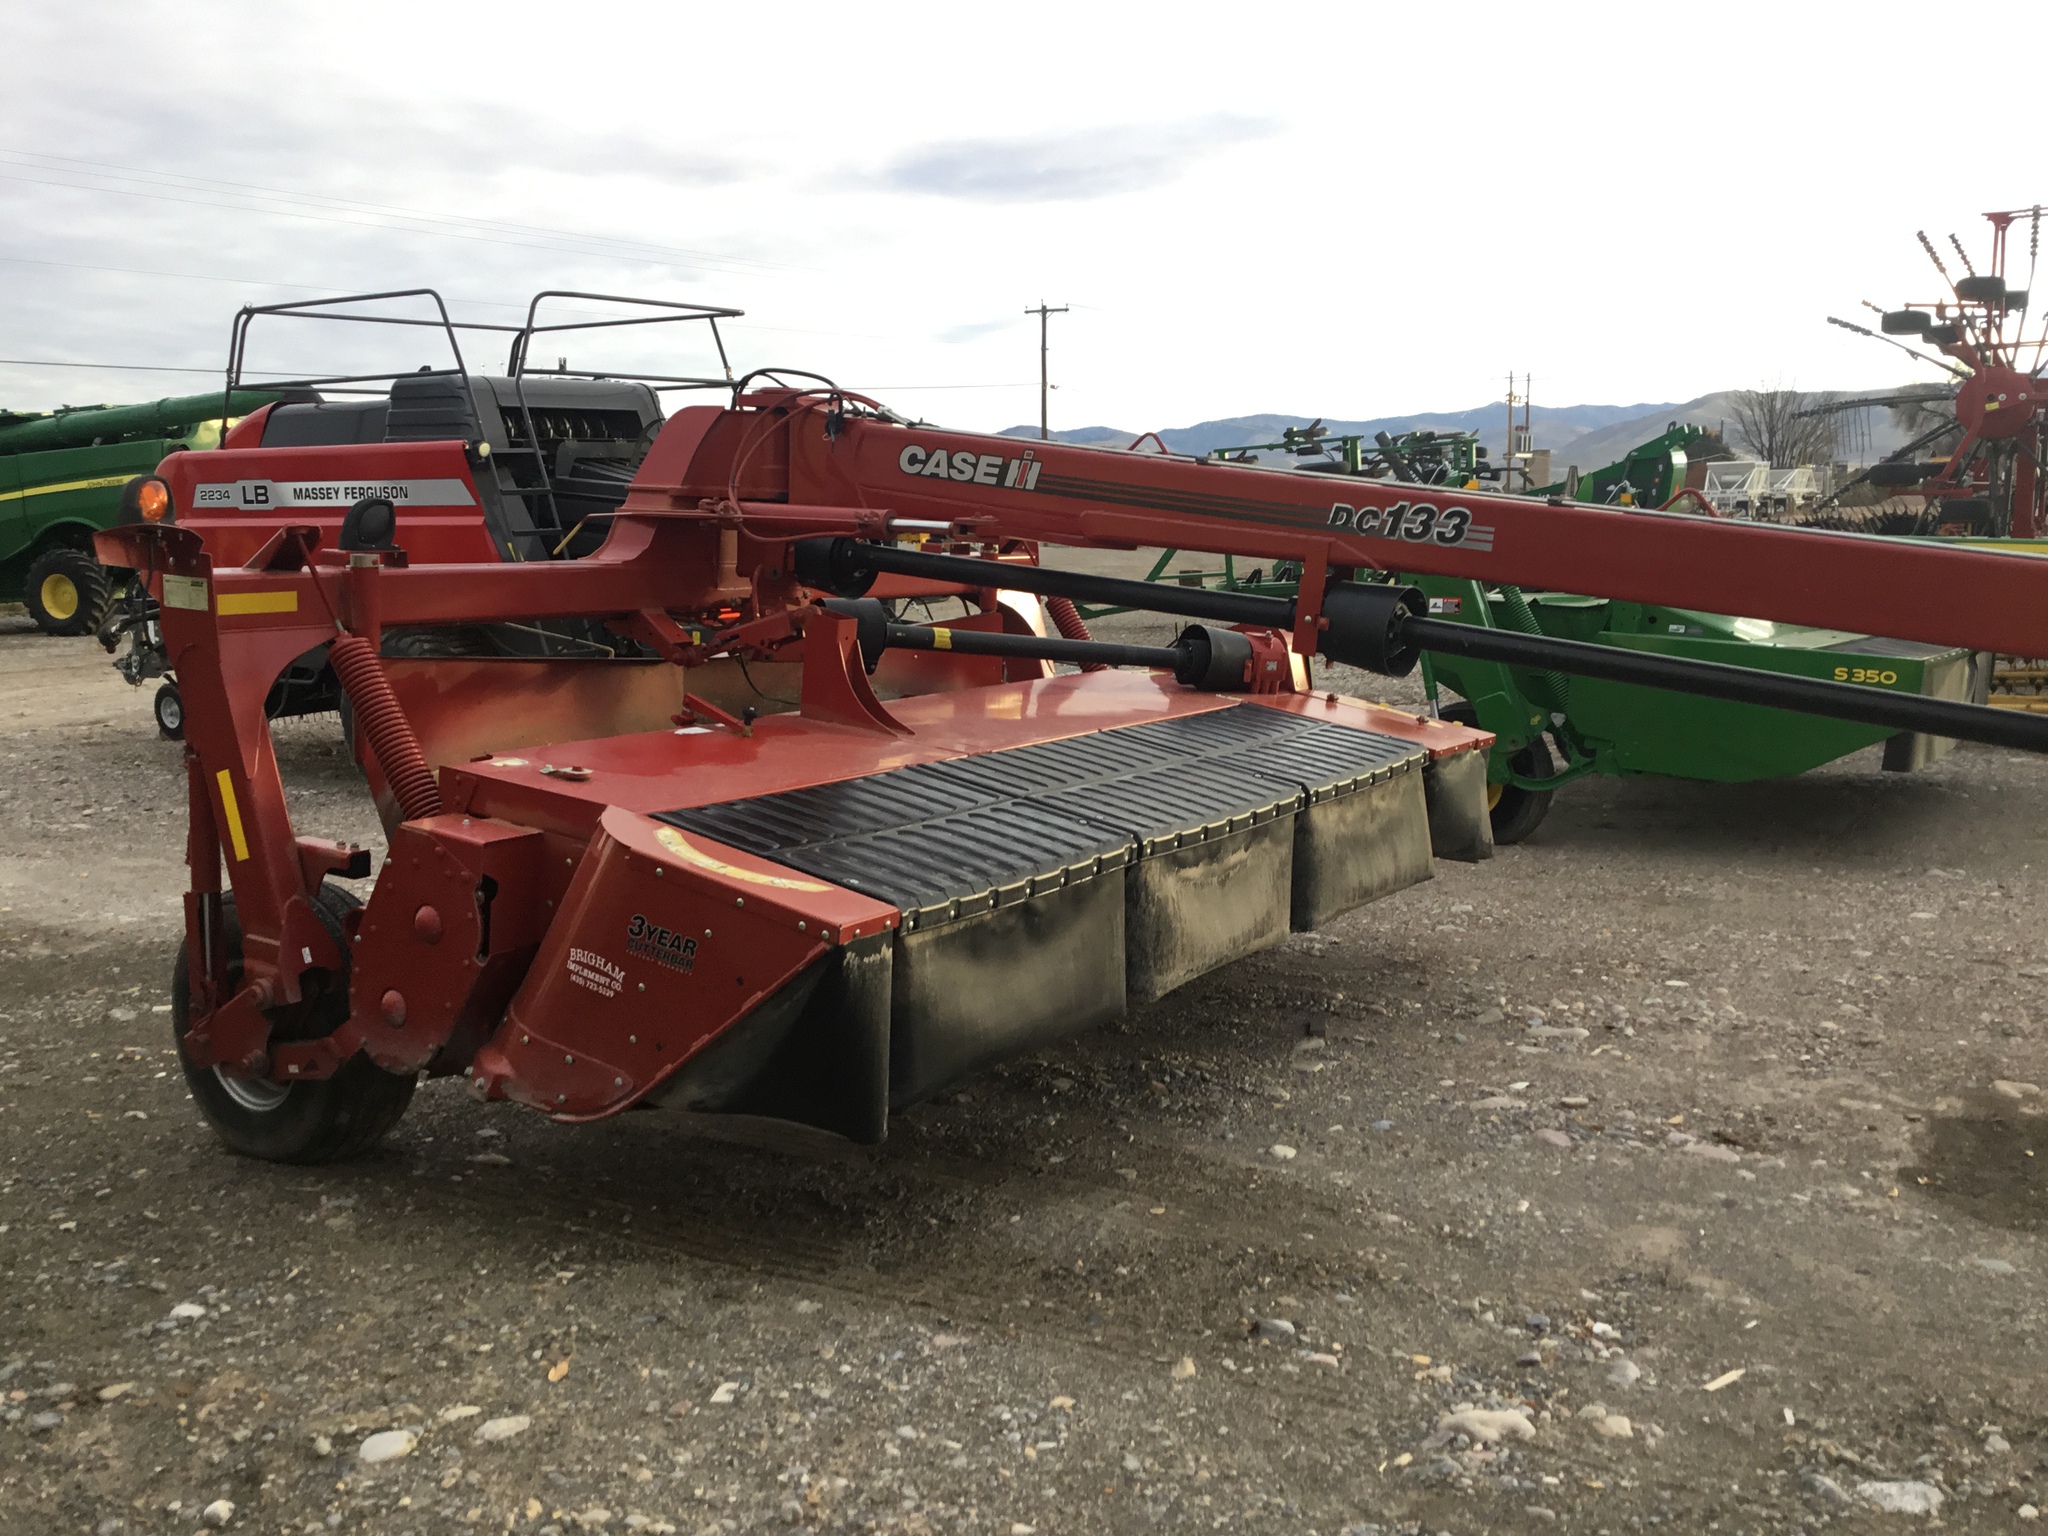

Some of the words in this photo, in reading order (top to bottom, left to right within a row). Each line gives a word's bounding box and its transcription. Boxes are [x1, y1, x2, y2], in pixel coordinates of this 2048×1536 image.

[899, 445, 1003, 485] CASE
[200, 490, 231, 500] 2234
[242, 485, 269, 504] LB
[293, 487, 340, 500] MASSEY
[344, 486, 408, 500] FERGUSON
[1834, 667, 1848, 681] S
[1852, 668, 1897, 684] 350
[627, 938, 694, 970] CUTTERBAR
[567, 960, 611, 986] IMPLEMENT
[570, 948, 626, 983] BRIGHAM
